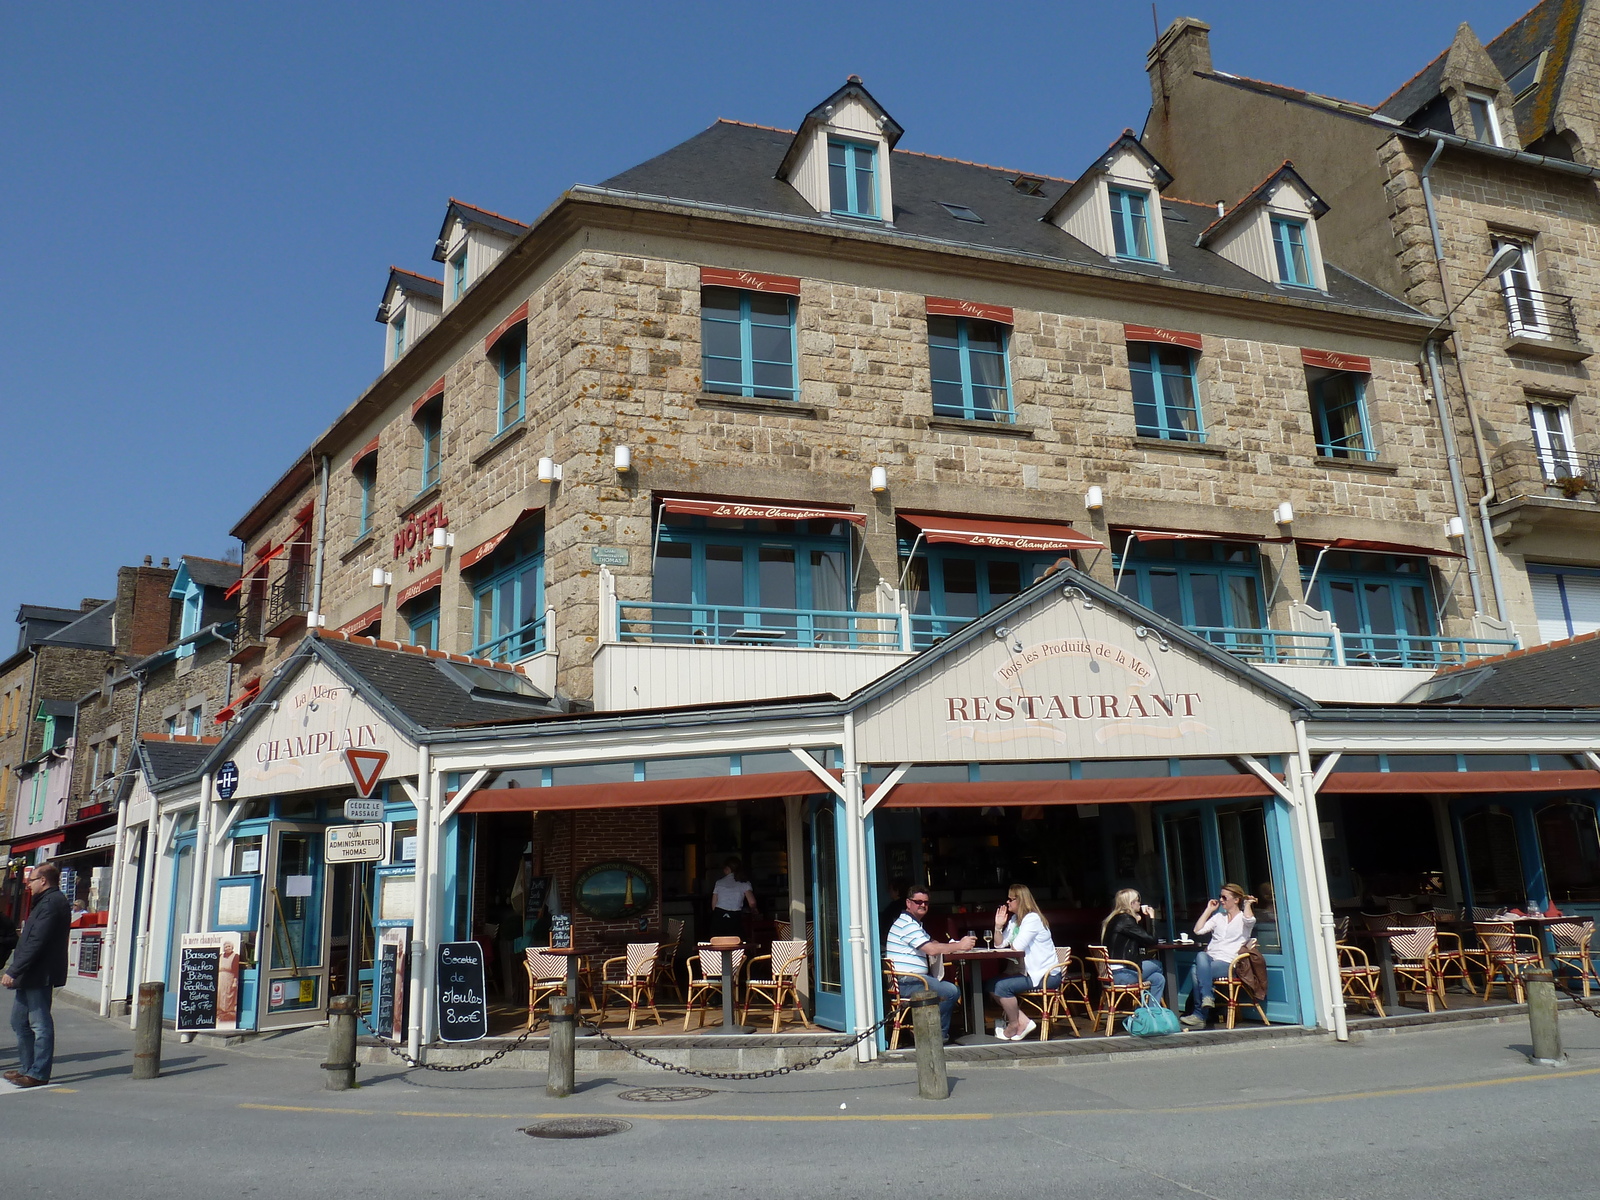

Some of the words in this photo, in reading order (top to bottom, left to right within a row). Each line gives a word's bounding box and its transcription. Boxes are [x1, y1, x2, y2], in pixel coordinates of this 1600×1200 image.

[713, 505, 731, 515] La
[734, 506, 764, 517] Mère
[765, 508, 826, 519] Champlain
[393, 502, 449, 560] HÔTEL
[970, 536, 985, 544] La
[987, 537, 1014, 546] Mère
[1014, 539, 1069, 550] Champlain
[998, 660, 1023, 681] Tous
[1022, 650, 1039, 664] les
[1041, 641, 1092, 657] Produits
[1095, 644, 1111, 658] de
[1115, 650, 1126, 665] la
[1127, 657, 1151, 680] Mer
[294, 693, 307, 709] La
[312, 685, 338, 701] Mère
[945, 692, 1202, 722] RESTAURANT
[256, 723, 379, 764] CHAMPLAIN
[222, 772, 232, 788] H
[350, 801, 370, 809] CÉDEZ
[329, 839, 380, 848] ADMINISTRATEUR
[342, 848, 367, 856] THOMAS
[442, 948, 478, 965] Cocotte
[450, 972, 465, 982] de
[442, 986, 482, 1004] Moules
